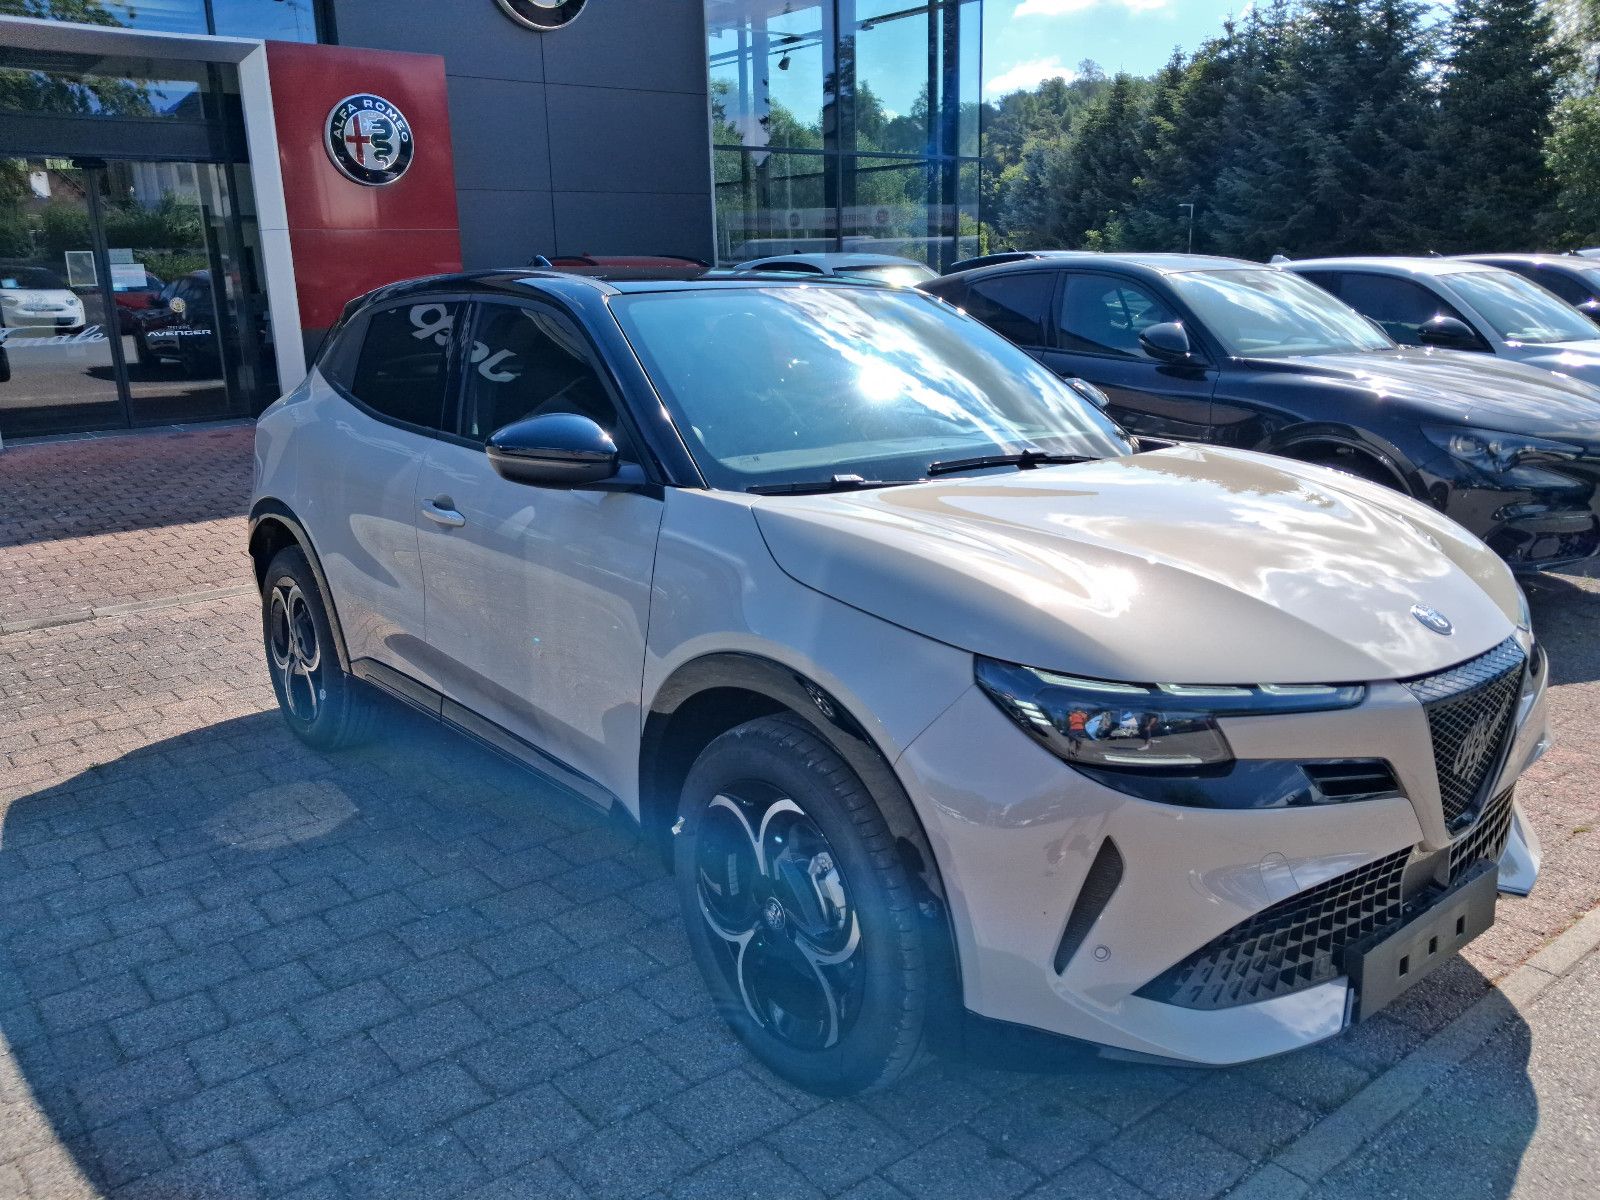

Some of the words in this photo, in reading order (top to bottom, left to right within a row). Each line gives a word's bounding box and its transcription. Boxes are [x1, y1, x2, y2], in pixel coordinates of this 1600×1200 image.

[333, 103, 357, 139] ALFA
[363, 99, 409, 142] ROMEO
[147, 329, 212, 337] AVENGER
